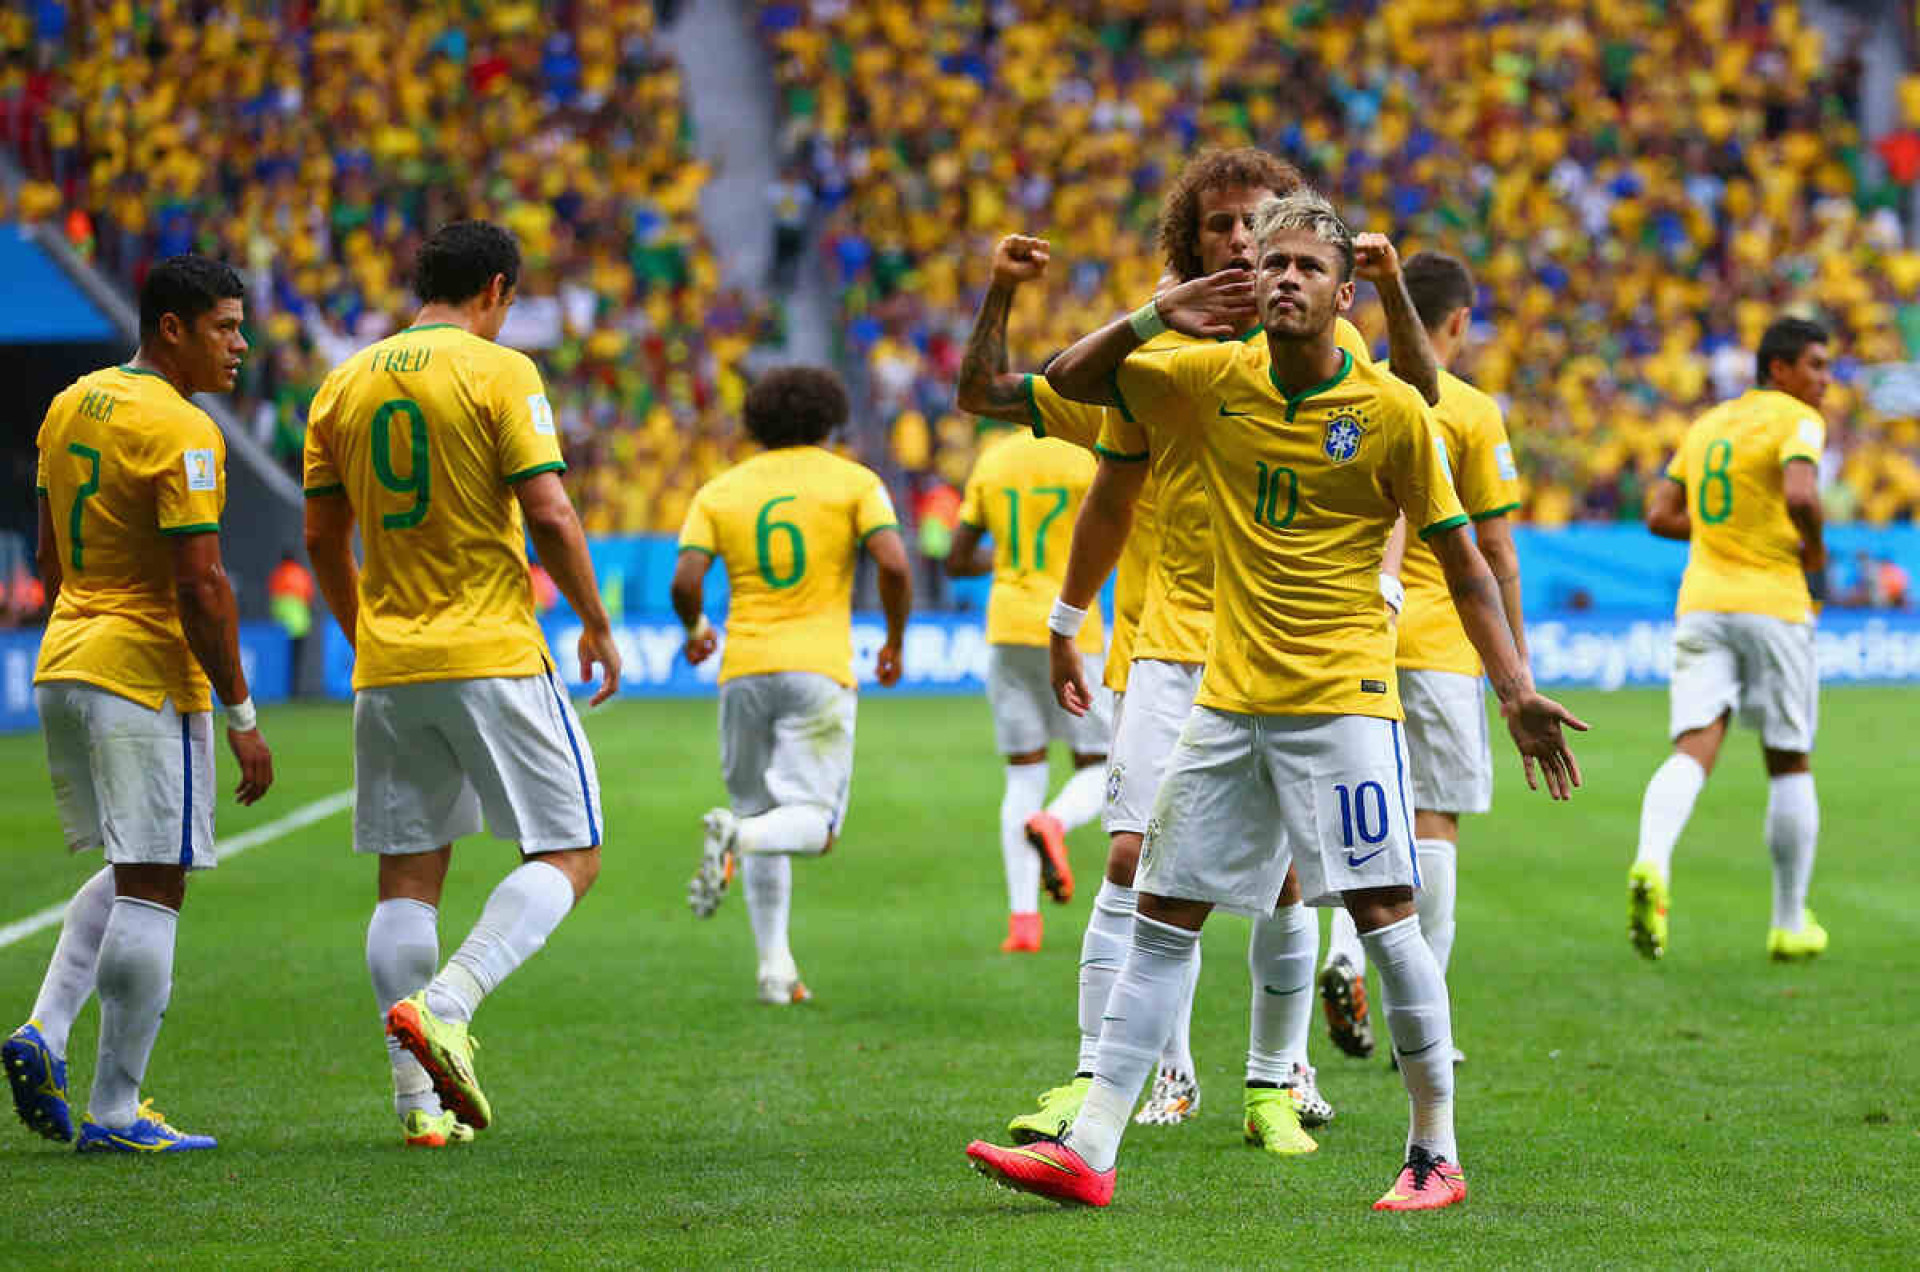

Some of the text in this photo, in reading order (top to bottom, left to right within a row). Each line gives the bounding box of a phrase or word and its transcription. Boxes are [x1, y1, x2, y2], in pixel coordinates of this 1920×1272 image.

[67, 442, 102, 571] 7
[371, 399, 432, 530] 9
[1254, 460, 1299, 529] 10
[1698, 438, 1734, 526] 8
[755, 495, 807, 590] 6
[1003, 486, 1070, 571] 17
[1334, 780, 1389, 847] 10
